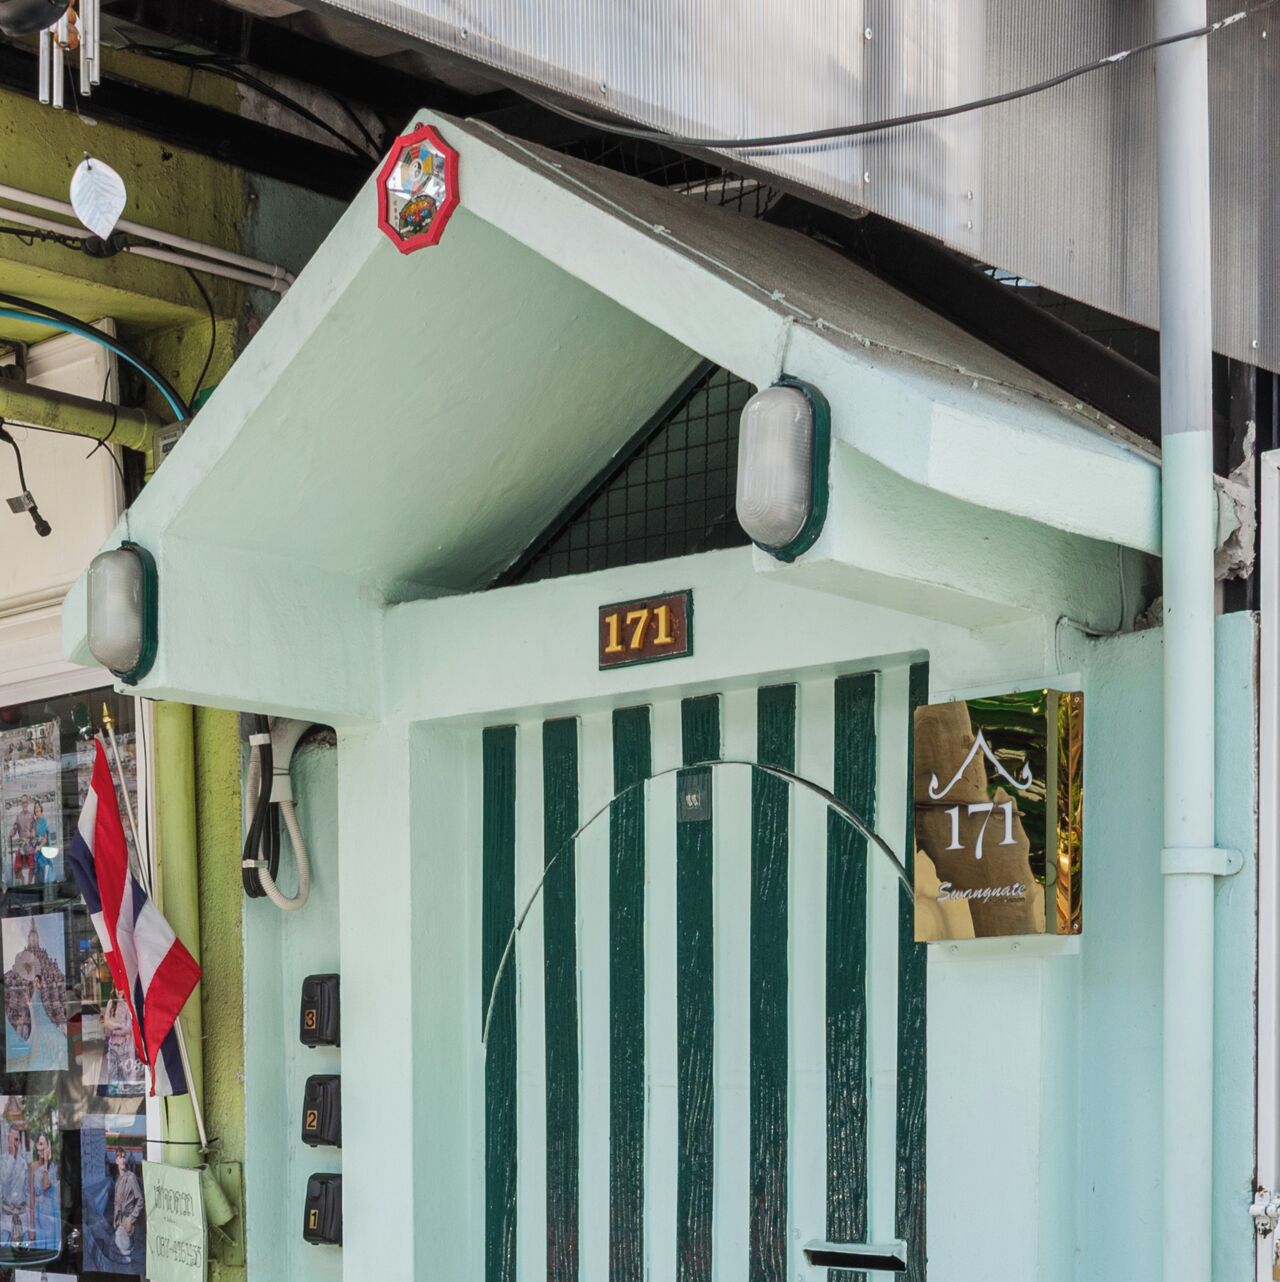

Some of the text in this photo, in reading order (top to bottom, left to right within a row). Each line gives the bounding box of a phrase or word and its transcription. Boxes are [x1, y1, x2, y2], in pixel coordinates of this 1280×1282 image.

[604, 604, 675, 653] 171
[944, 800, 1019, 860] 171
[305, 1011, 315, 1028] 3
[307, 1112, 316, 1128] 2
[310, 1211, 317, 1228] 1
